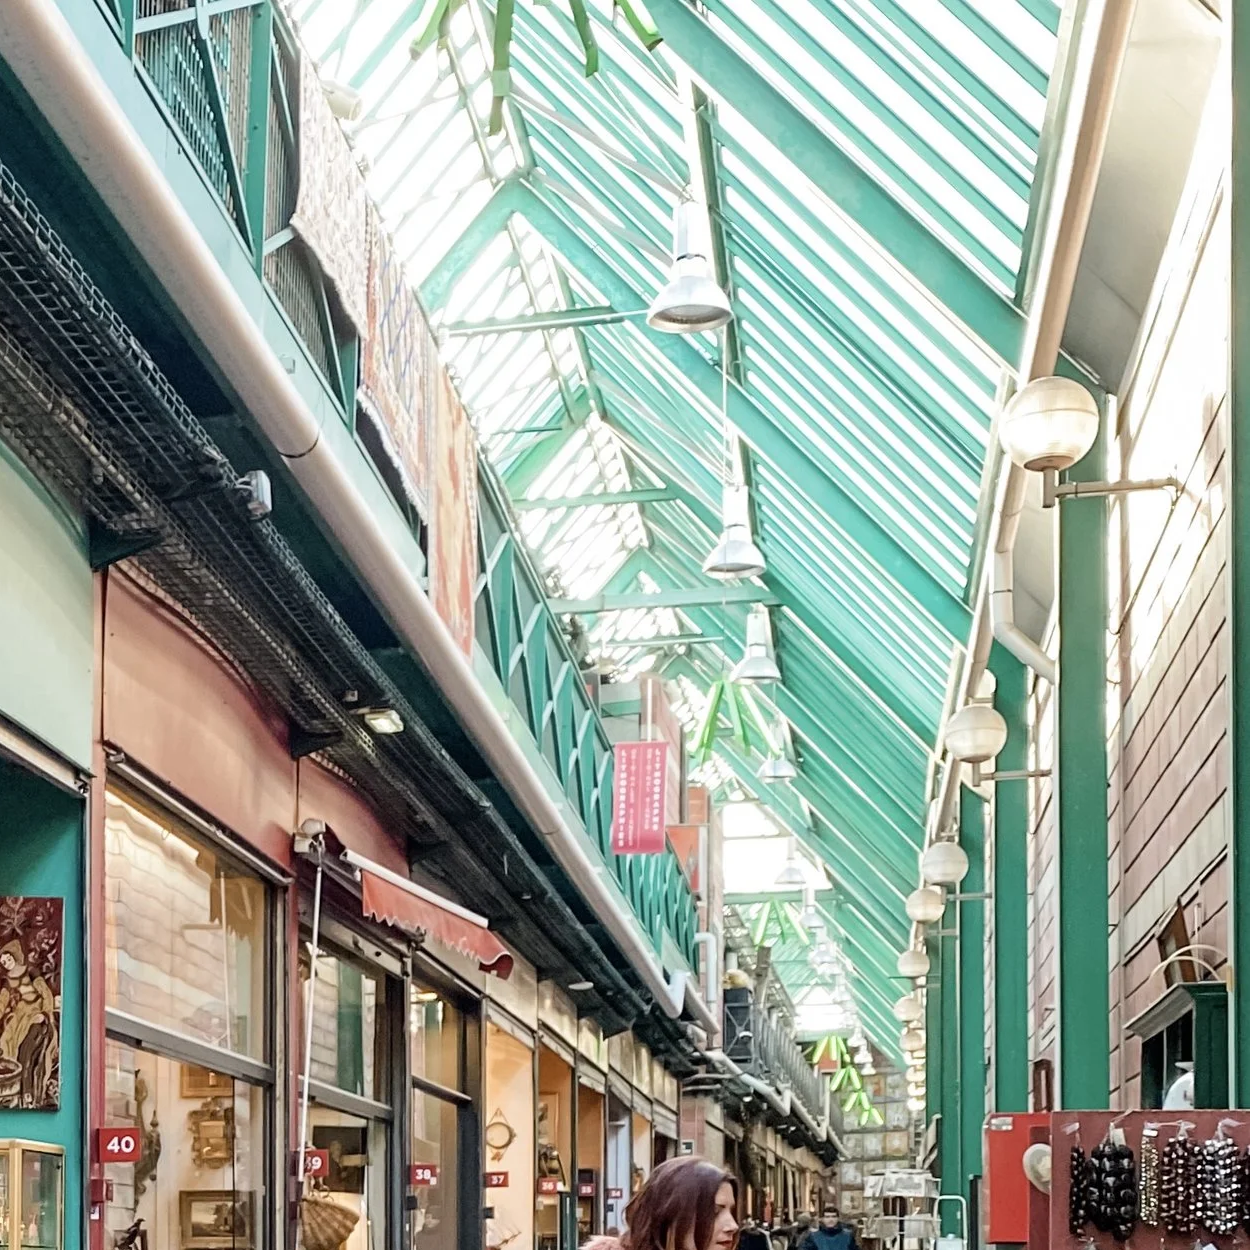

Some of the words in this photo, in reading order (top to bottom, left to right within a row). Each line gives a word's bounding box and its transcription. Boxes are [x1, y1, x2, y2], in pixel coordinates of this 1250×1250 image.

[618, 749, 627, 847] LITHOGRAPHIES
[652, 748, 661, 831] LITHOGRAPHS
[107, 1136, 135, 1154] 40
[415, 1169, 432, 1180] 38
[491, 1175, 505, 1185] 37
